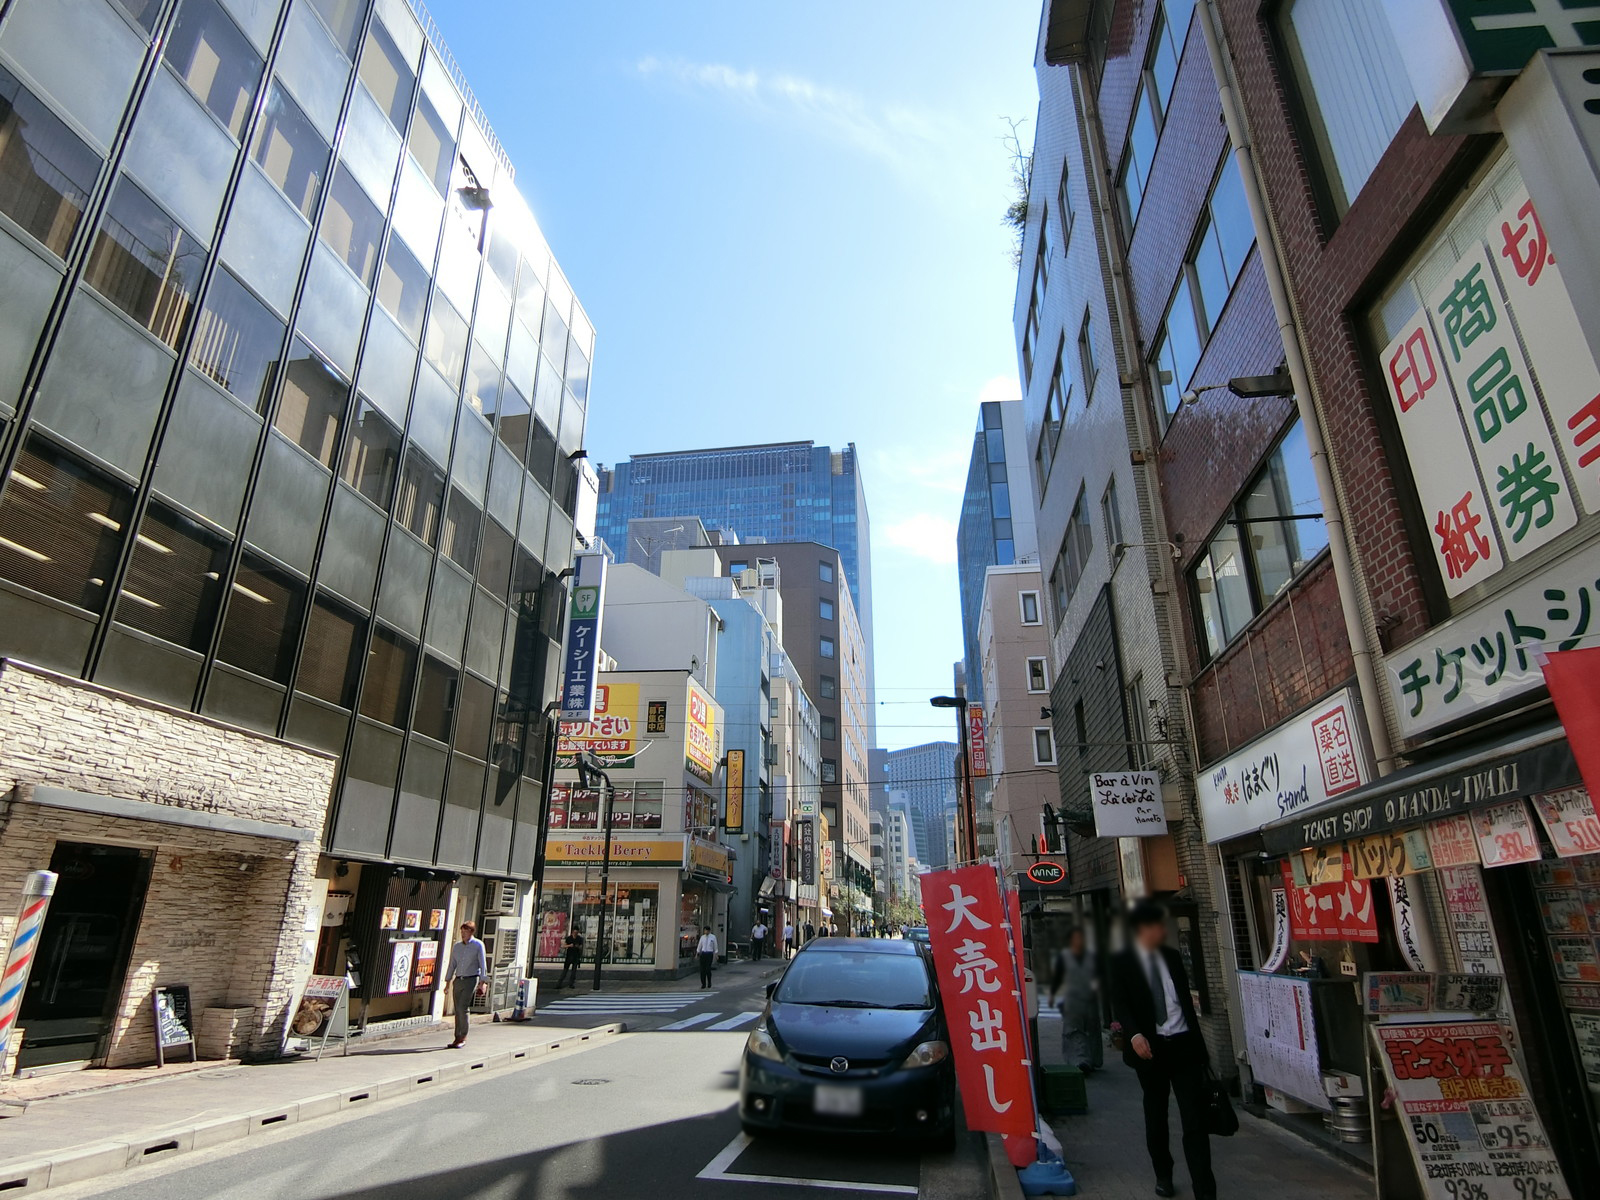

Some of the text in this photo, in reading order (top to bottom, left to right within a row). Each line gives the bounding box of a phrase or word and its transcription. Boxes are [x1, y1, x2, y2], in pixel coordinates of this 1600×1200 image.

[1438, 262, 1560, 544] 商品券
[1389, 327, 1491, 580] 印紙
[581, 594, 591, 602] 5F
[1399, 578, 1600, 718] チケットシ
[557, 741, 628, 750] も販売しています
[1094, 775, 1117, 788] Bar
[1131, 774, 1154, 786] Vin
[1242, 752, 1280, 805] はまぐり
[551, 788, 647, 800] 2F ルアーーナー
[549, 811, 563, 823] 1F
[614, 844, 652, 859] Berry
[1033, 868, 1060, 877] WINE
[941, 884, 1013, 1114] 大売出し
[1385, 1036, 1513, 1080] 記念切手
[1439, 1076, 1524, 1100] 割引販売中
